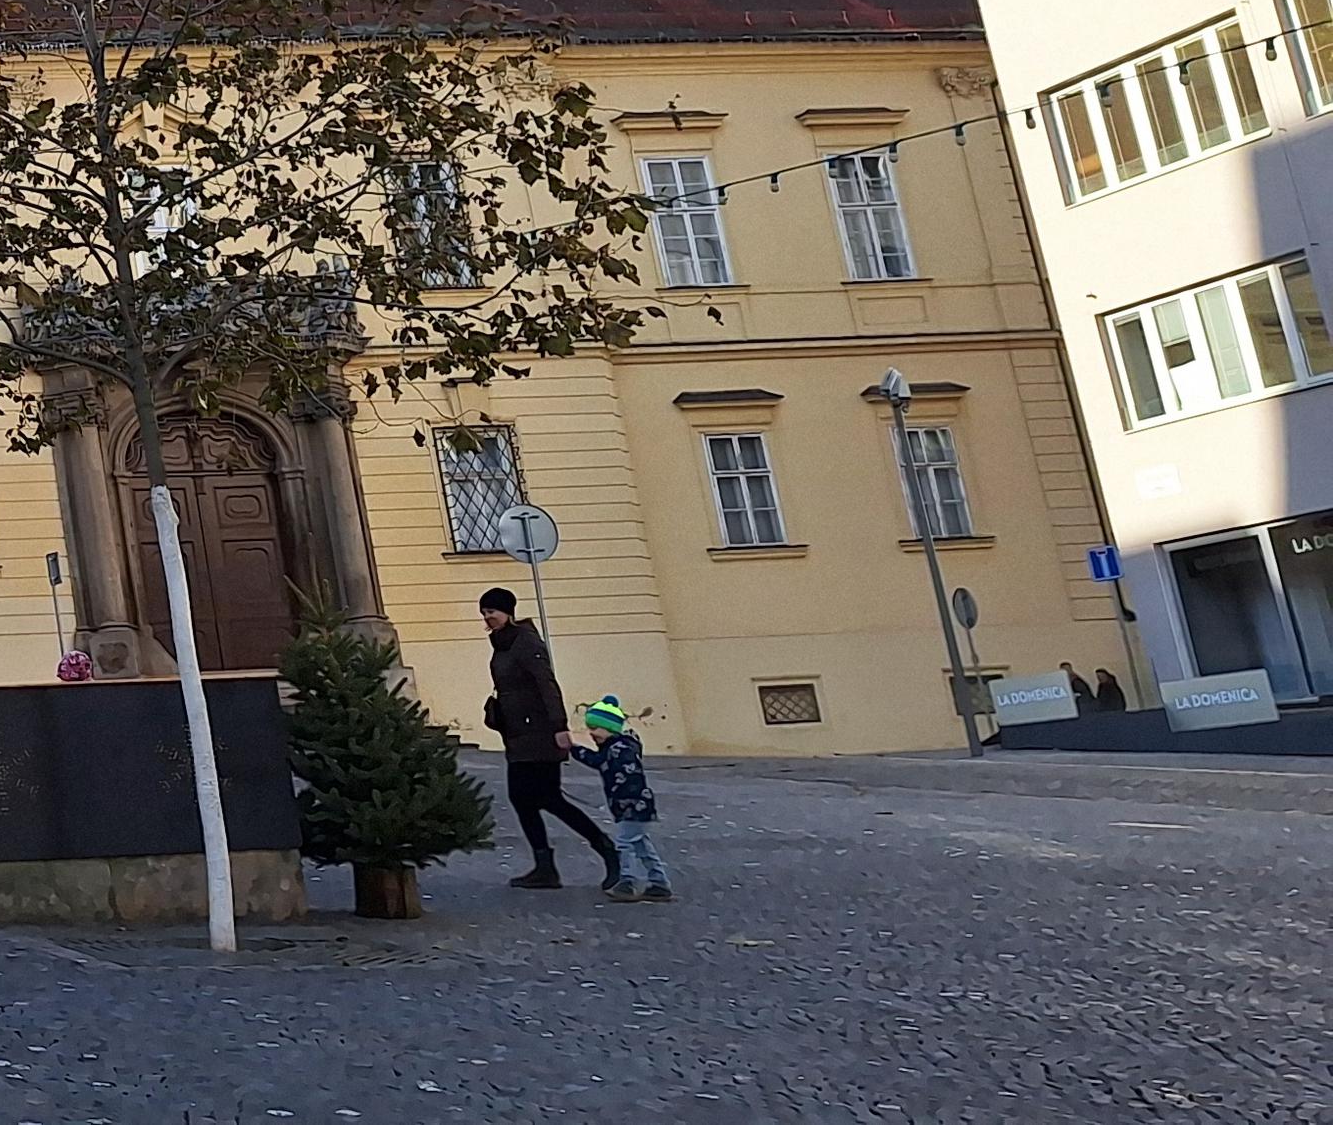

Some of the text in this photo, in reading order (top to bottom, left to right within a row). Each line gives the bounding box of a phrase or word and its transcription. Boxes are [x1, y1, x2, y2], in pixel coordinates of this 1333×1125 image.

[1291, 538, 1313, 553] LA
[997, 686, 1068, 706] LA DOMENICA
[1175, 688, 1259, 709] LA DOMENICA
